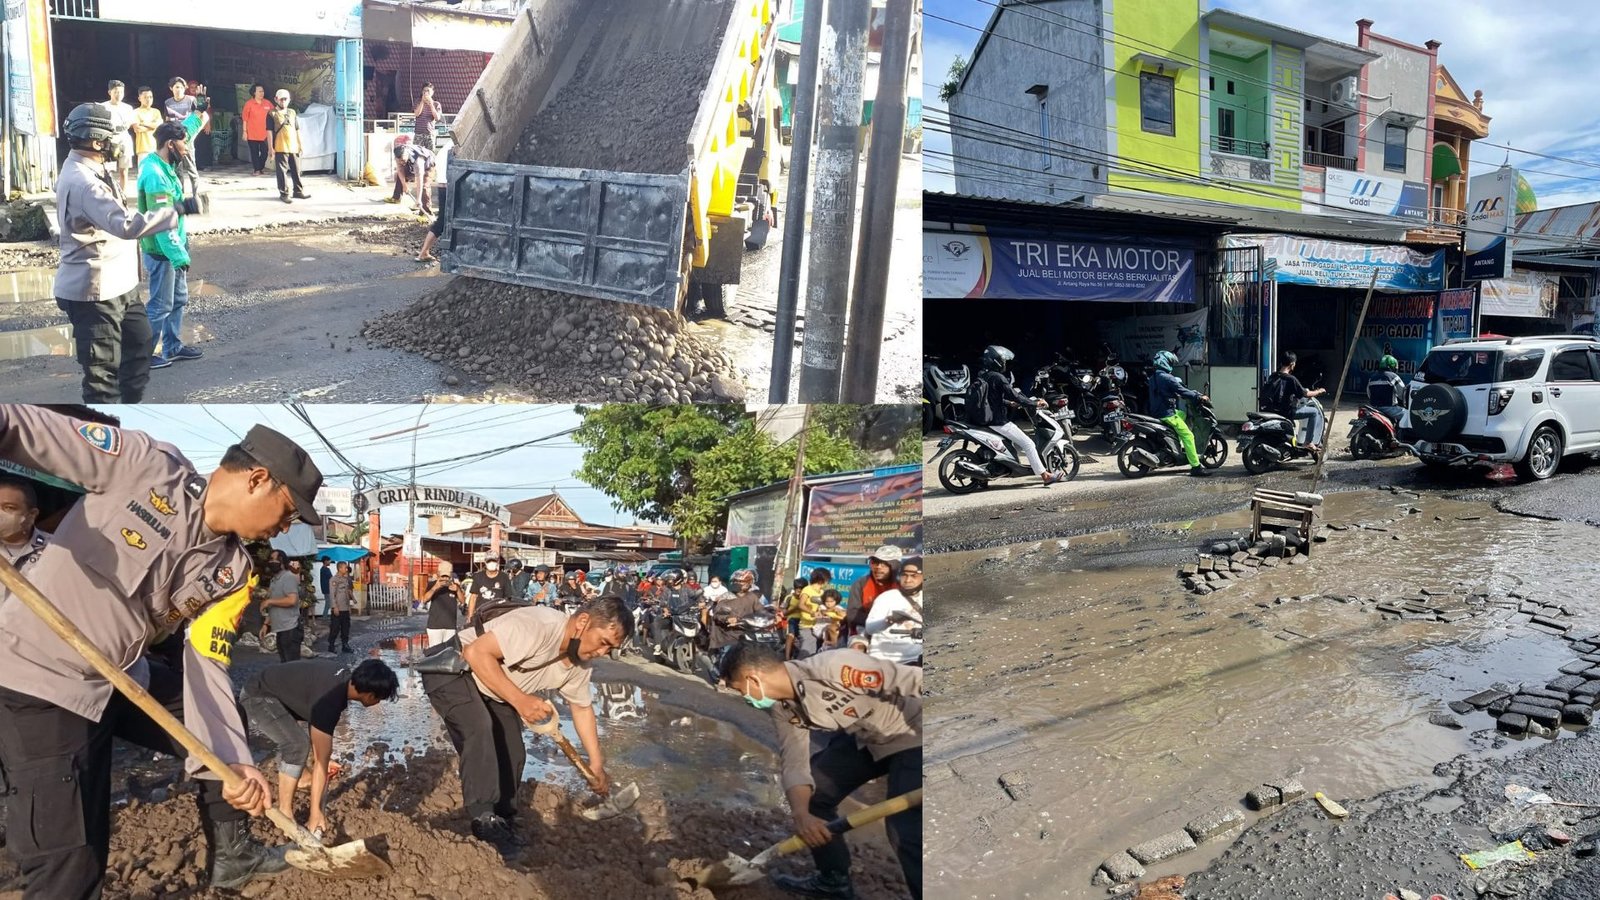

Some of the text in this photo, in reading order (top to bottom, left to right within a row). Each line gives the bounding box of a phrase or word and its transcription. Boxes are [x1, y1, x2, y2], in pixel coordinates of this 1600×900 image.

[1349, 196, 1370, 206] Gadai
[1404, 209, 1424, 217] ANTANG
[1010, 241, 1182, 271] TRI EKA MOTOR
[1474, 258, 1494, 266] ANTANG
[1018, 269, 1177, 282] JUAL BELI MOTOR BEKAS BERKUALITAS
[1386, 324, 1424, 339] GADAI
[1360, 360, 1416, 374] JUA ELI
[378, 487, 500, 517] GRIYA RINDU ALAM
